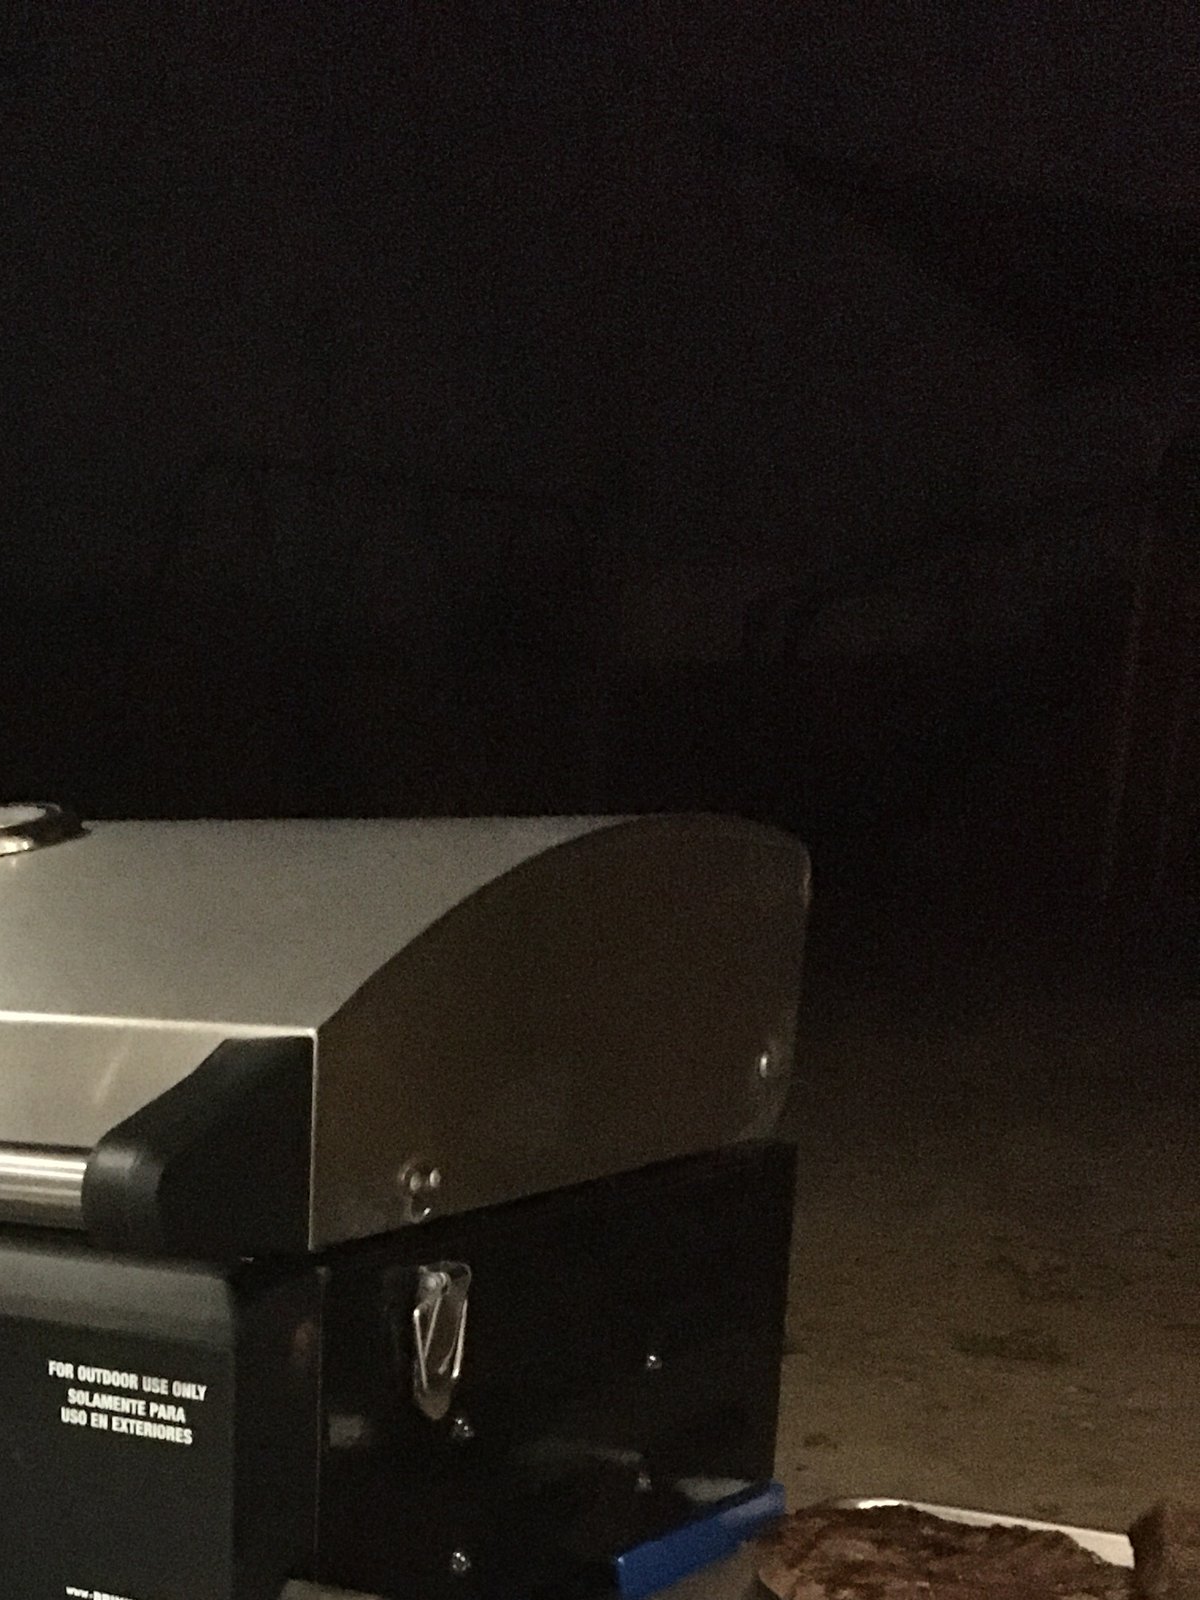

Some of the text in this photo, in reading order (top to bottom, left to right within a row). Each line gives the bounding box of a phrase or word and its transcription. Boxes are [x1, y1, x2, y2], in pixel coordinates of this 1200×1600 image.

[48, 1360, 207, 1401] FOR OUTDOOR USE ONLY
[68, 1388, 186, 1424] SOLAMENTE PARA
[61, 1407, 193, 1445] USO EN EXTERIORES
